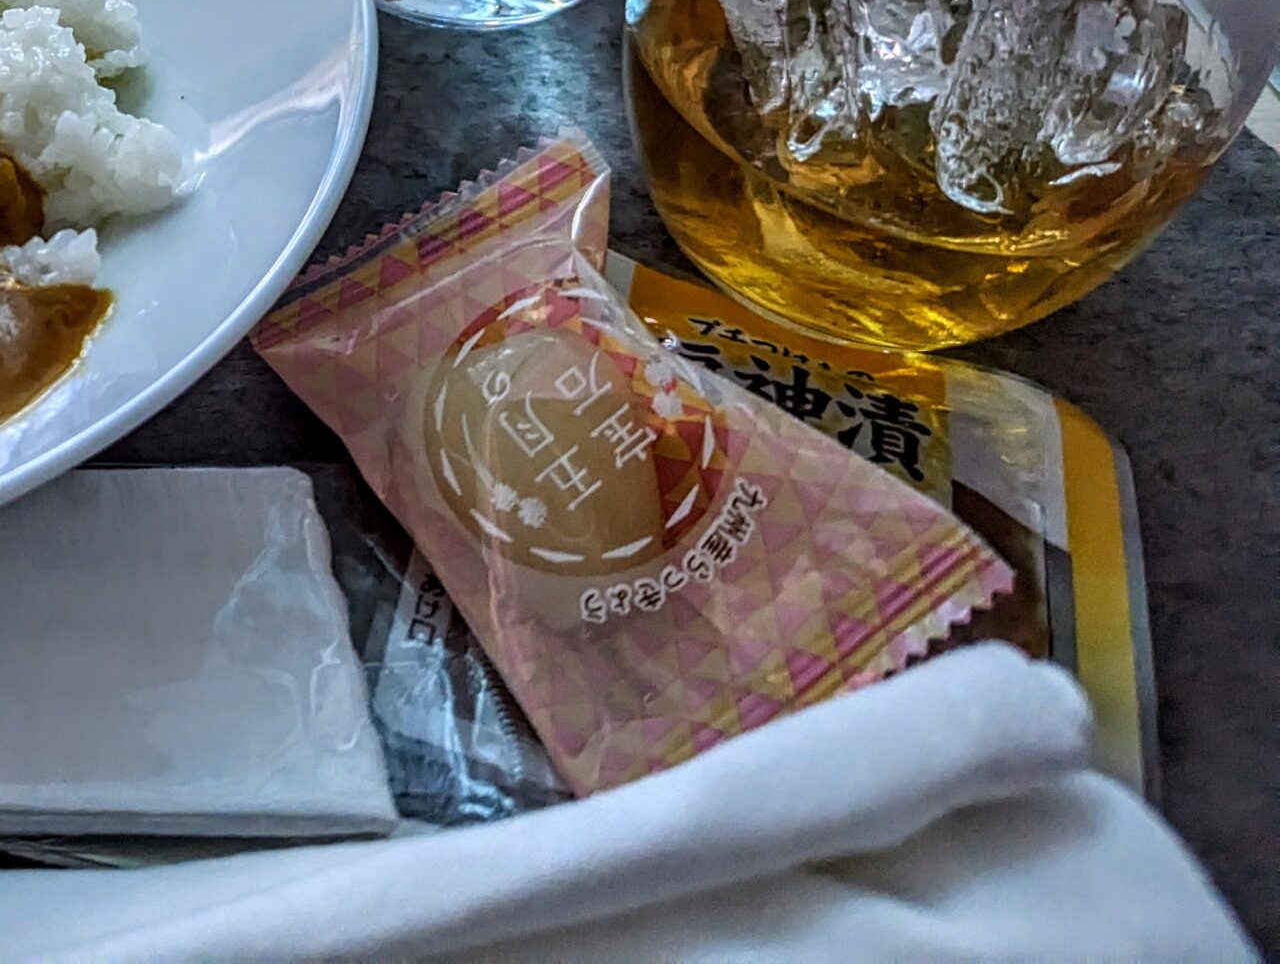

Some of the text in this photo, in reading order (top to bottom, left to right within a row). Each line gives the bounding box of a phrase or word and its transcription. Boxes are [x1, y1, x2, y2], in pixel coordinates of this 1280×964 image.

[482, 371, 603, 511] 五月の
[554, 350, 657, 469] 宝石
